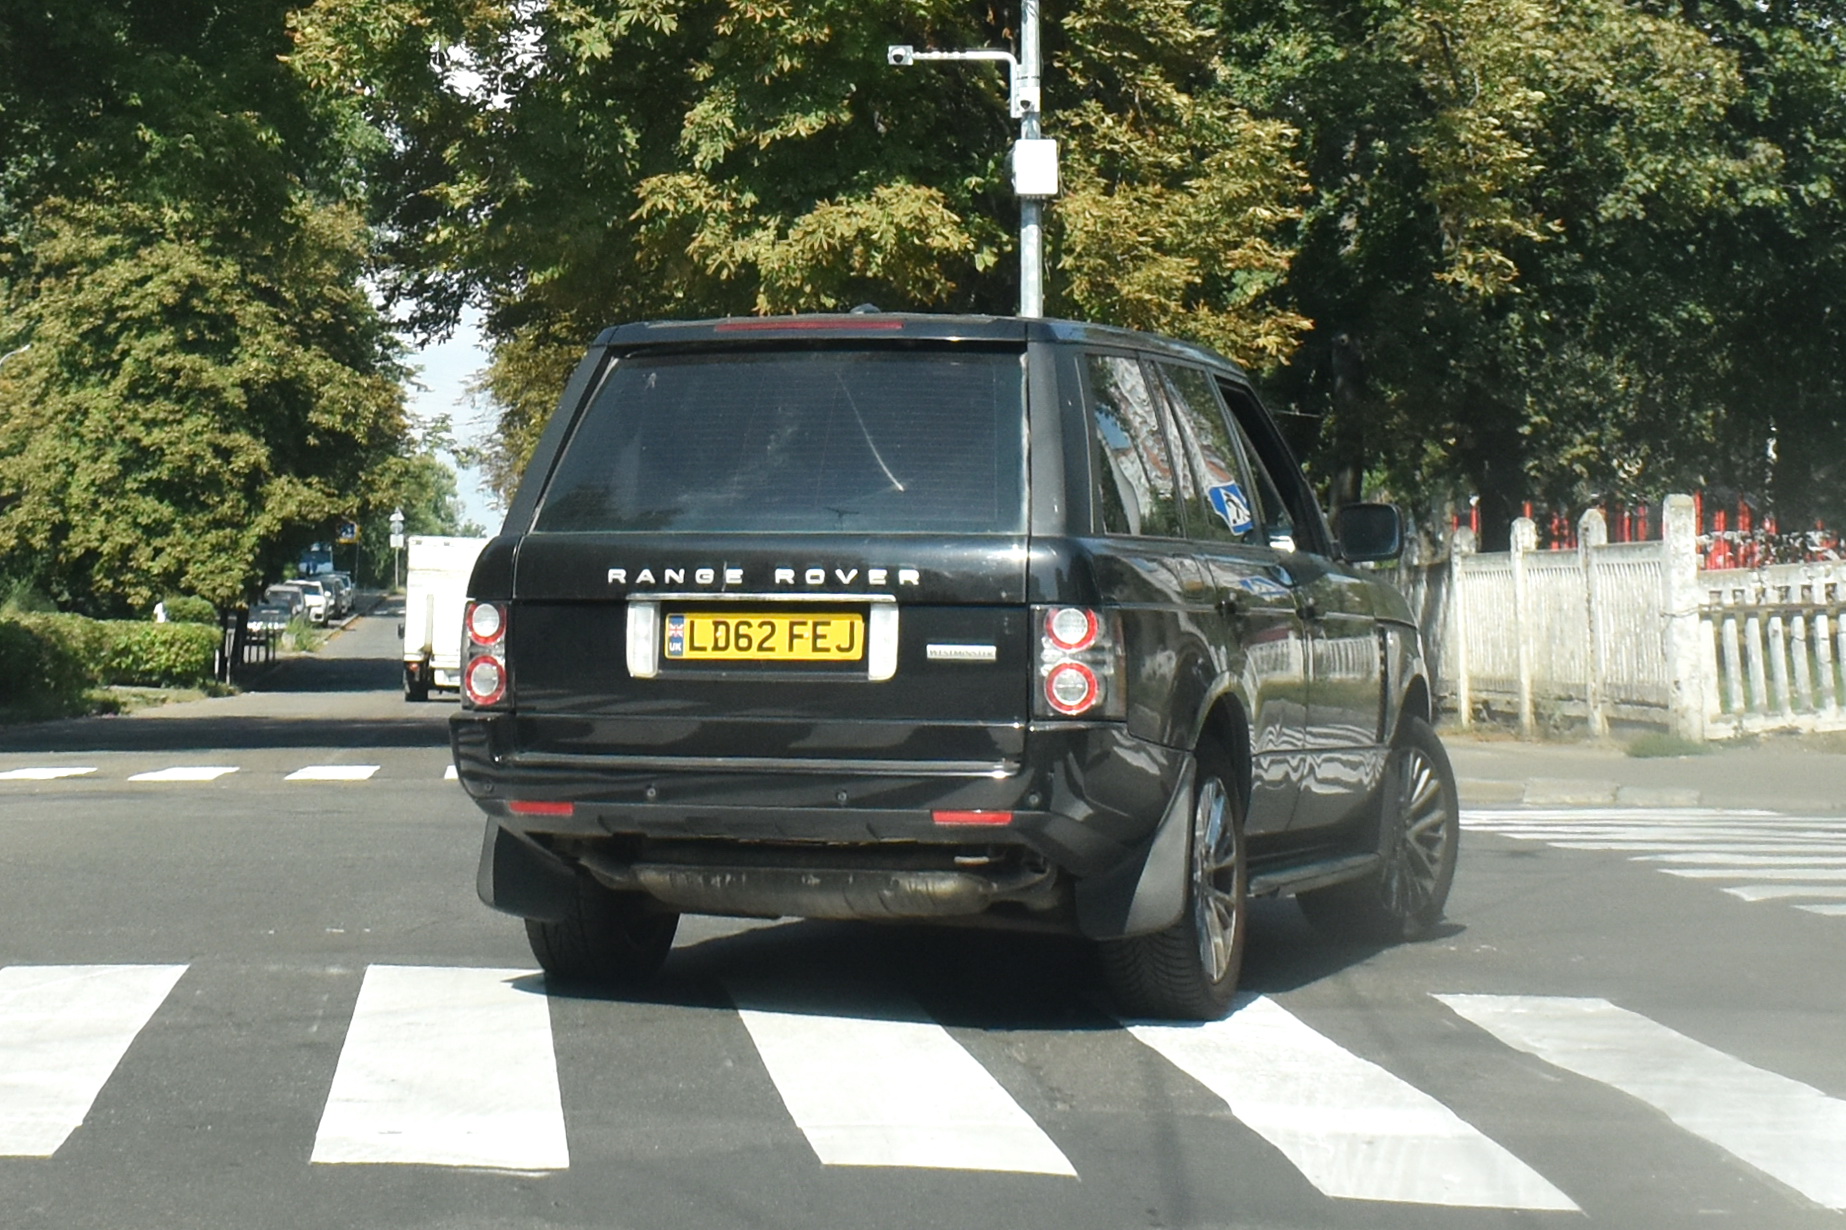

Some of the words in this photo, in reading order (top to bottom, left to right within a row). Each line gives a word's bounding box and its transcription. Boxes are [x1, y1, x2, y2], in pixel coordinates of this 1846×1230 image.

[607, 568, 743, 585] RANGE
[775, 568, 920, 585] ROVER
[688, 620, 777, 652] LD62
[788, 620, 855, 653] FEJ
[669, 641, 682, 652] UK
